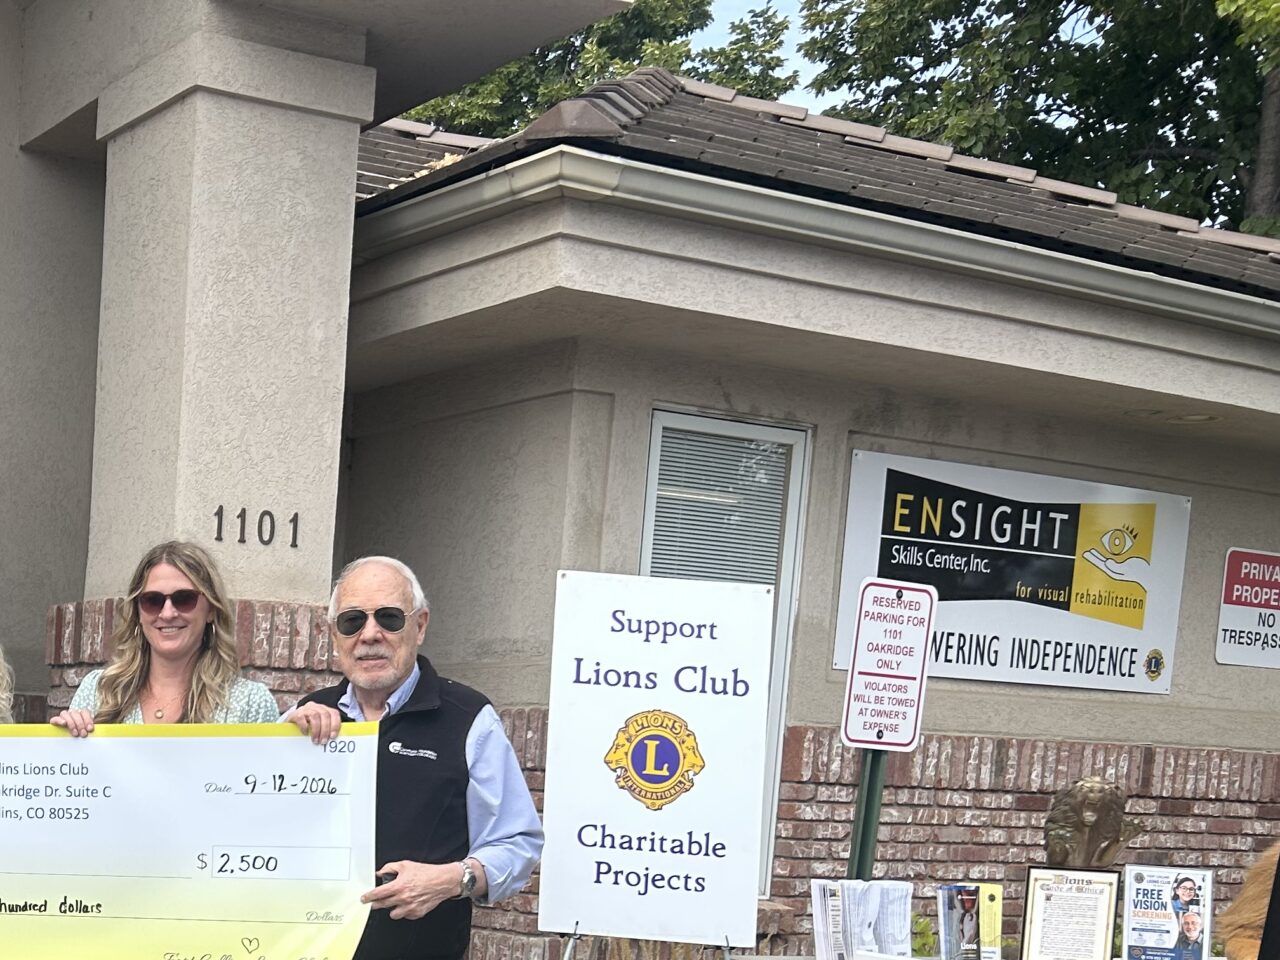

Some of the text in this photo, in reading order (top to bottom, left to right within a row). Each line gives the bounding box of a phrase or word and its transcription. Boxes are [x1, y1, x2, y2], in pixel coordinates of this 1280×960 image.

[213, 504, 299, 548] 1101
[892, 491, 1070, 550] ENSIGHT
[890, 543, 991, 574] Skills Center, Inc.
[1240, 561, 1280, 582] PRIVA
[872, 595, 921, 612] RESERVED
[1015, 581, 1144, 611] for visual rehabilitation
[1232, 584, 1280, 606] PROPE
[610, 609, 718, 643] Support
[863, 610, 926, 628] PARKING FOR
[1257, 611, 1276, 628] NO
[883, 628, 903, 641] 1101
[1221, 628, 1280, 649] TRESPAS
[866, 642, 915, 657] OAKRIDGE
[928, 630, 1138, 678] WERING INDEPENDENCE
[876, 658, 902, 671] ONLY
[572, 656, 750, 697] Lions Club
[864, 681, 909, 694] VIOLATORS
[853, 693, 915, 708] WILL BE TOWED
[857, 706, 907, 721] AT OWNER'S
[631, 713, 682, 736] LIONS
[862, 720, 900, 733] EXPENSE
[322, 740, 356, 753] 1920
[641, 739, 670, 776] L
[23, 763, 56, 777] Lions
[59, 763, 89, 777] Club
[44, 785, 62, 798] Dr.
[65, 785, 99, 798] Suite
[102, 786, 112, 798] C
[204, 782, 232, 793] Date
[623, 774, 687, 800] INTERNATIONAL
[26, 807, 45, 820] CO
[48, 807, 90, 820] 80525
[577, 823, 727, 858] Charitable
[196, 852, 208, 870] $
[593, 860, 706, 896] Projects
[1135, 888, 1163, 900] FREE
[58, 896, 102, 914] dollars
[1132, 899, 1167, 911] VISION
[306, 911, 344, 922] Dollars
[1131, 910, 1172, 920] SCREENING
[961, 942, 978, 950] Lions
